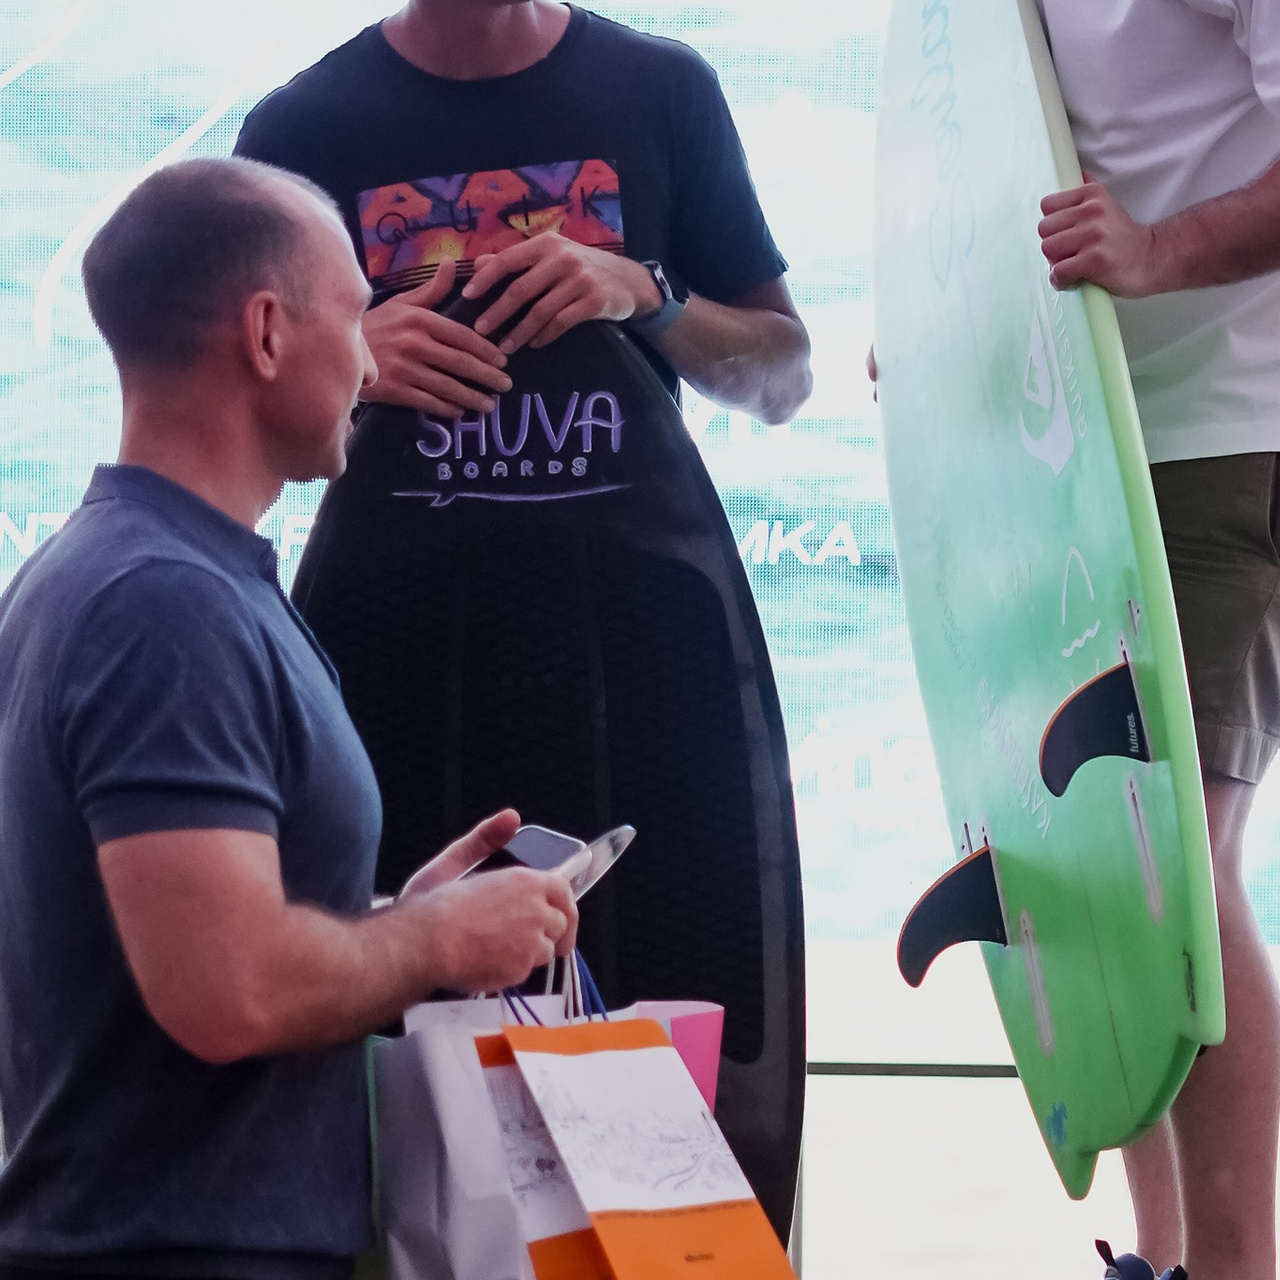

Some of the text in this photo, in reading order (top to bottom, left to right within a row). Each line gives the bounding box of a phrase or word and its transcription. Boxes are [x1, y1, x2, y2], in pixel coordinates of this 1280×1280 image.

[416, 391, 626, 458] SHUVA
[437, 457, 588, 480] BOARDS
[1126, 711, 1140, 753] futures.
